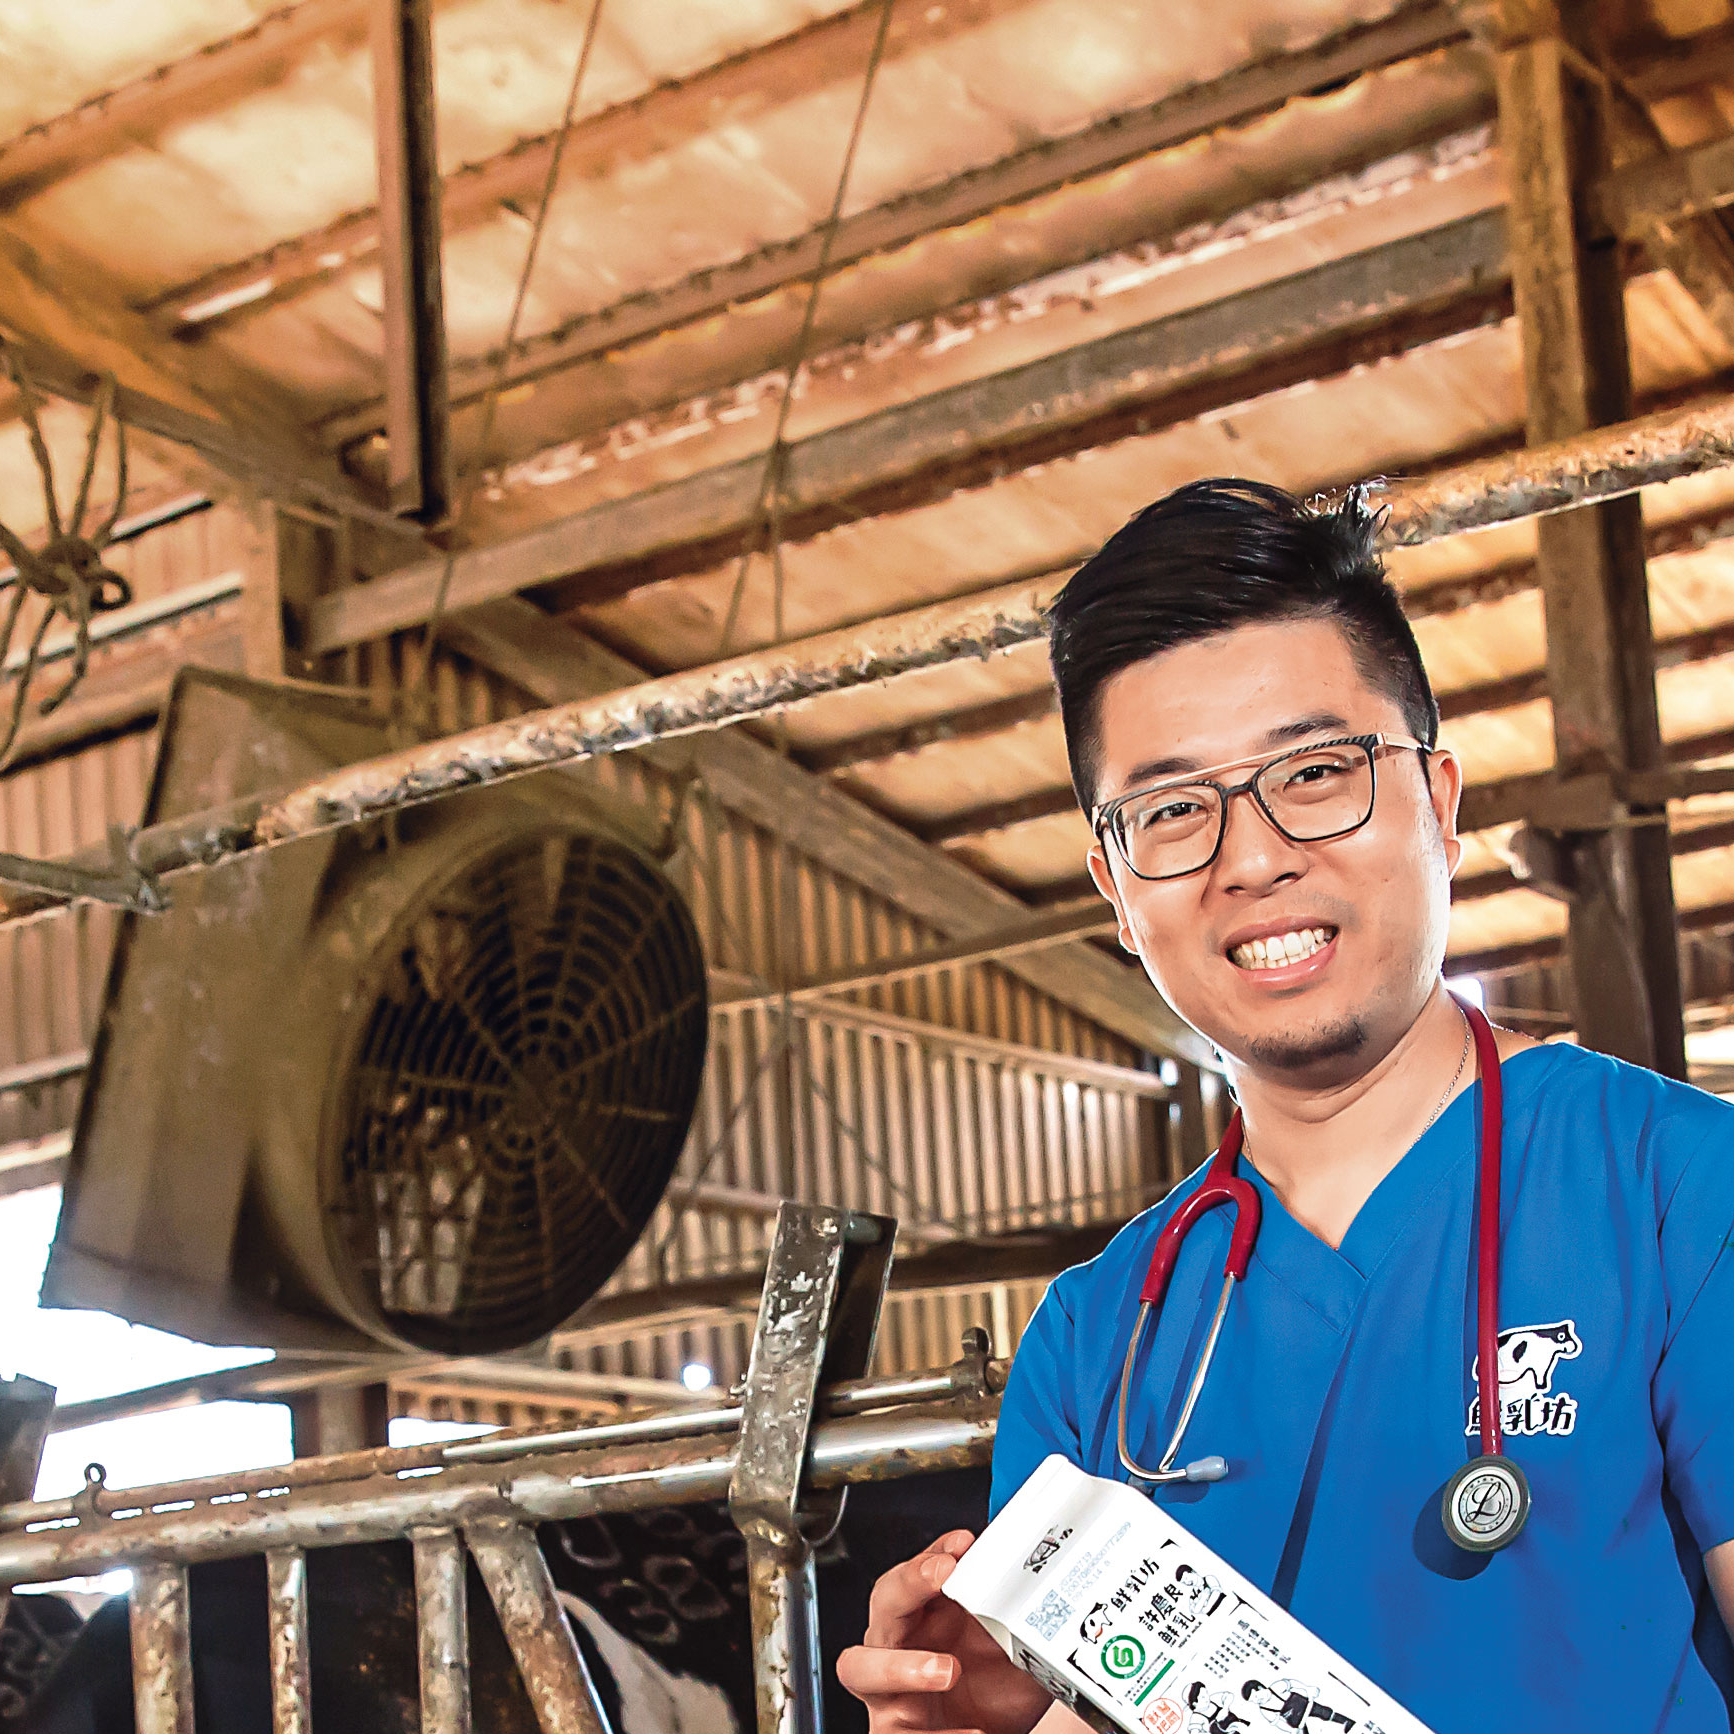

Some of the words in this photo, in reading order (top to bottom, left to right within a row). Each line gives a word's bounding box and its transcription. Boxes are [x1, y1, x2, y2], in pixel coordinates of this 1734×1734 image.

[1111, 1559, 1159, 1612] 鮮乳坊
[1139, 1584, 1183, 1631] 許慶良
[1158, 1612, 1196, 1647] 鮮乳
